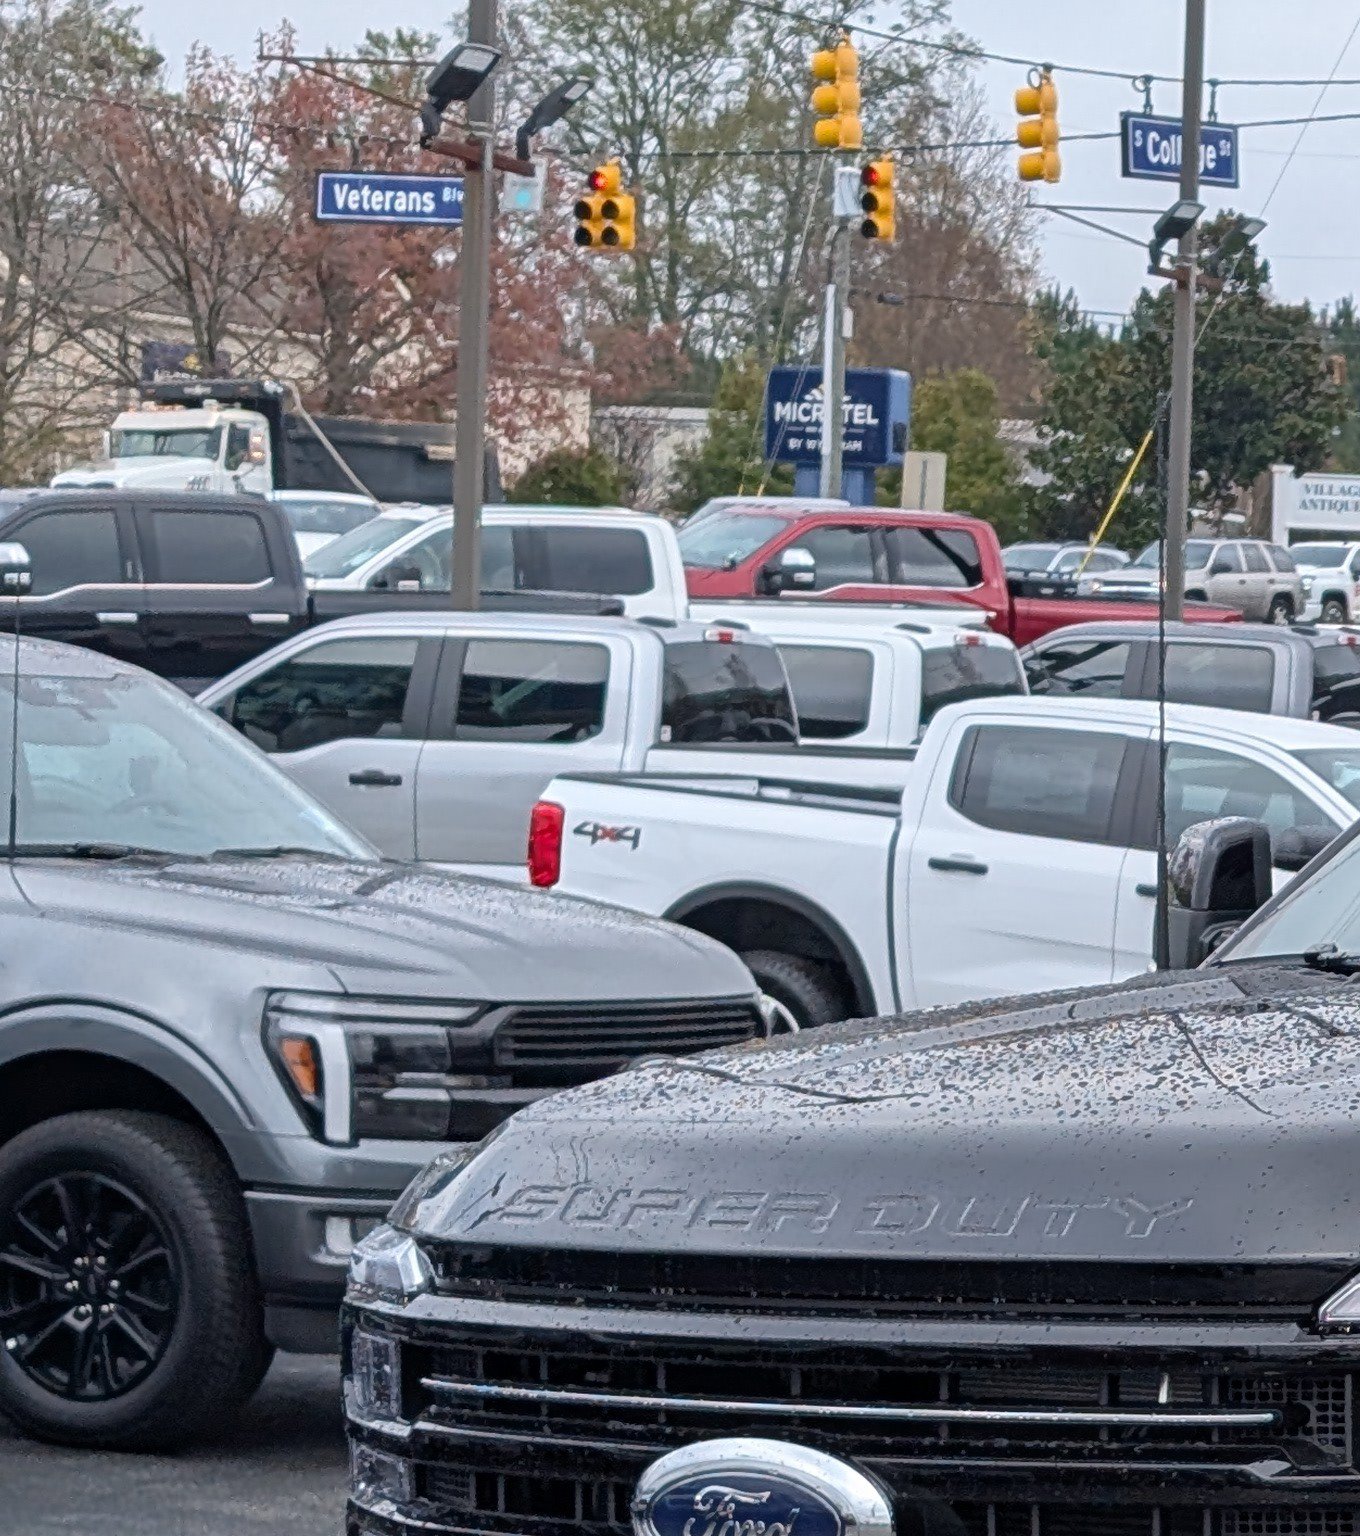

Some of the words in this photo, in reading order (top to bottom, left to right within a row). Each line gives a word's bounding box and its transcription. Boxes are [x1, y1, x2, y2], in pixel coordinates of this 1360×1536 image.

[1134, 129, 1143, 147] S
[1147, 131, 1217, 174] Colle
[333, 183, 436, 213] Veterans
[442, 187, 464, 203] Blv
[774, 401, 879, 425] MICRTEL
[497, 1180, 841, 1235] SUPER
[853, 1192, 1194, 1238] DUTY
